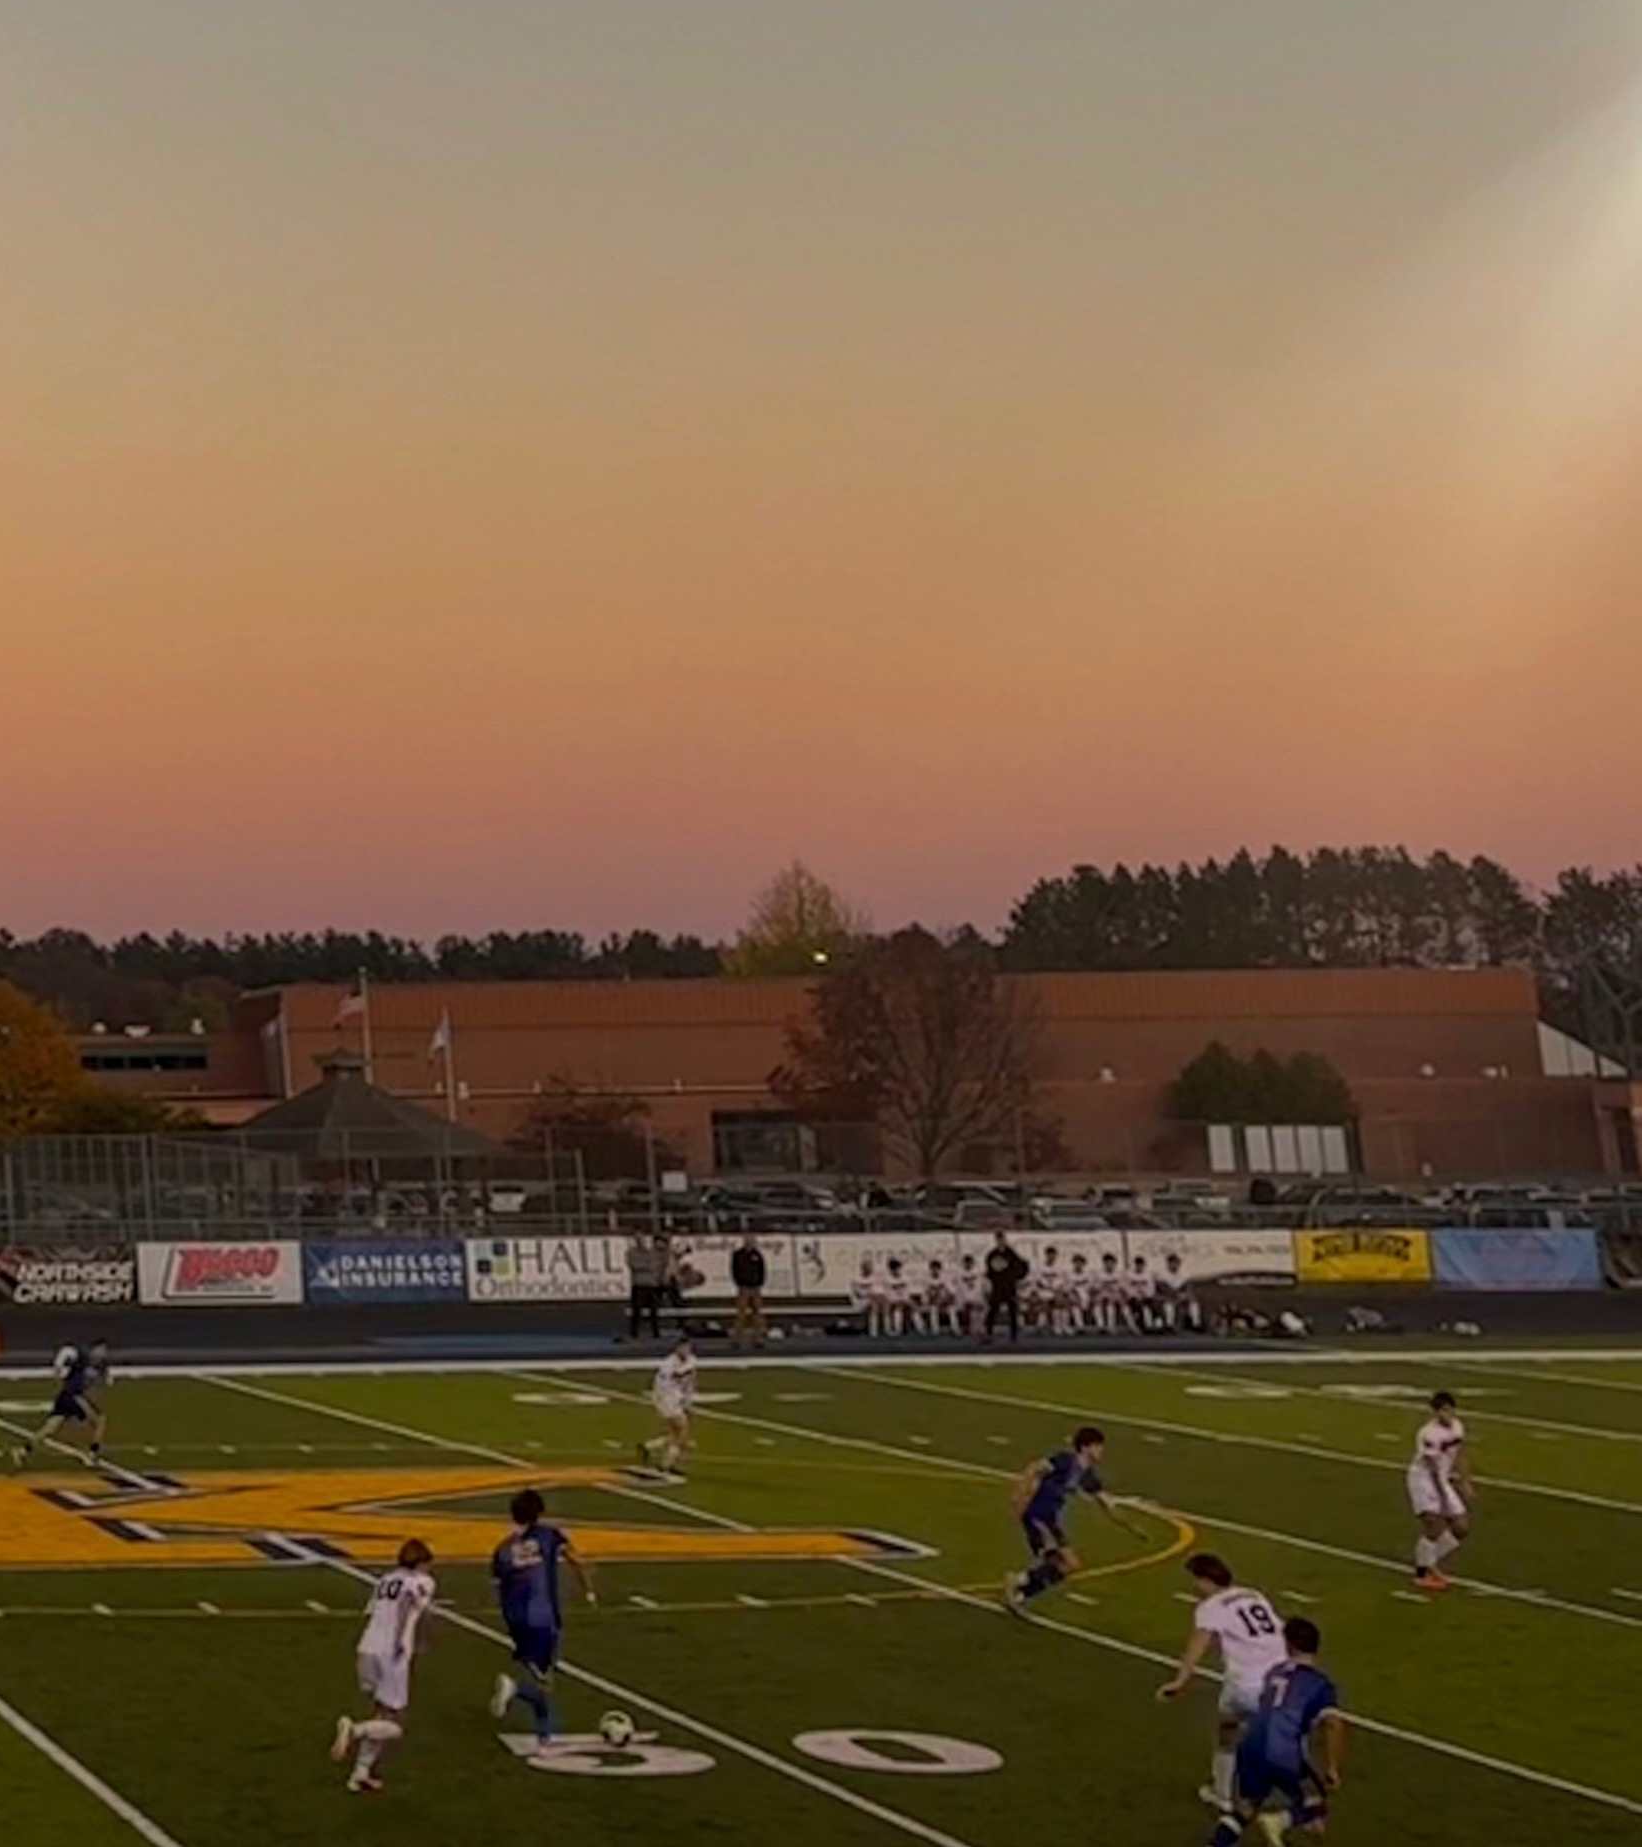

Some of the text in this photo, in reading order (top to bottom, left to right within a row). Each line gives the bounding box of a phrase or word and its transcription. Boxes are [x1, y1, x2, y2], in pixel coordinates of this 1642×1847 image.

[341, 1254, 463, 1271] DANIELSON
[514, 1239, 625, 1274] HALL
[16, 1260, 134, 1282] NORTHSIDE
[341, 1270, 463, 1288] INSURANCE
[475, 1275, 627, 1297] Orthodontics
[1237, 1605, 1275, 1638] 19
